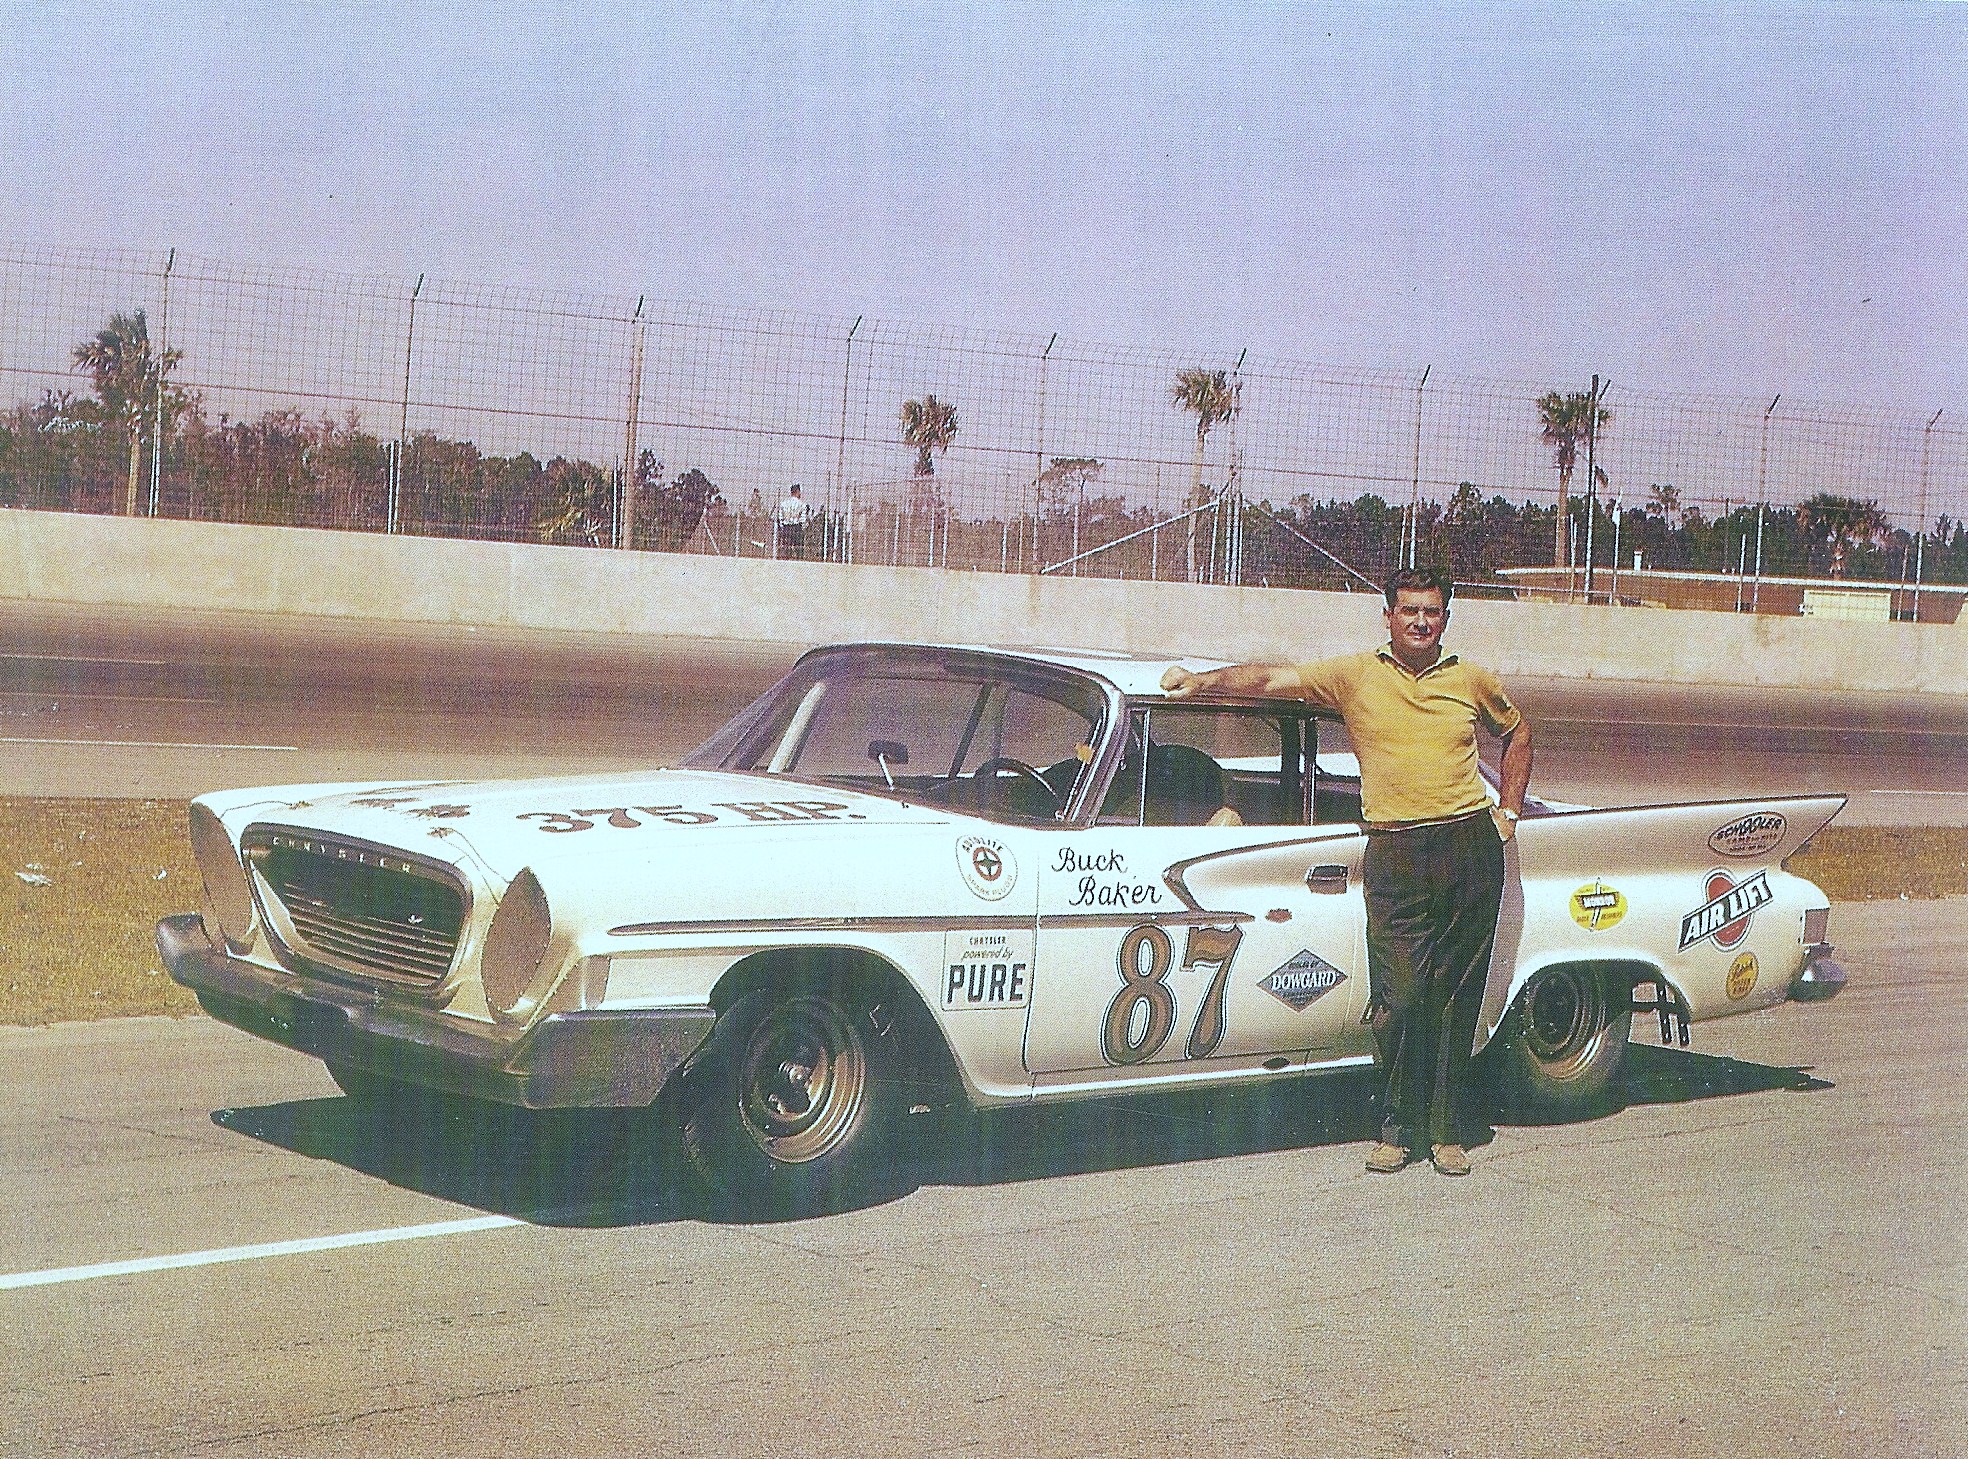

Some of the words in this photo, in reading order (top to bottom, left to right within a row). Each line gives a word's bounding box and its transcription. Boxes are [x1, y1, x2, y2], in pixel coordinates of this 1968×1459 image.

[514, 803, 718, 834] 375
[1716, 815, 1782, 840] SCHOOLER
[1051, 846, 1129, 874] Buck
[1068, 873, 1163, 909] Baker
[1683, 902, 1726, 945] AIR
[1728, 874, 1771, 920] LIFT
[961, 945, 1003, 962] powered
[1002, 946, 1014, 961] by
[969, 935, 1007, 946] CHRYSLER
[947, 962, 1027, 1005] PURE
[1100, 922, 1246, 1066] 87
[1270, 970, 1338, 991] DOWGARD
